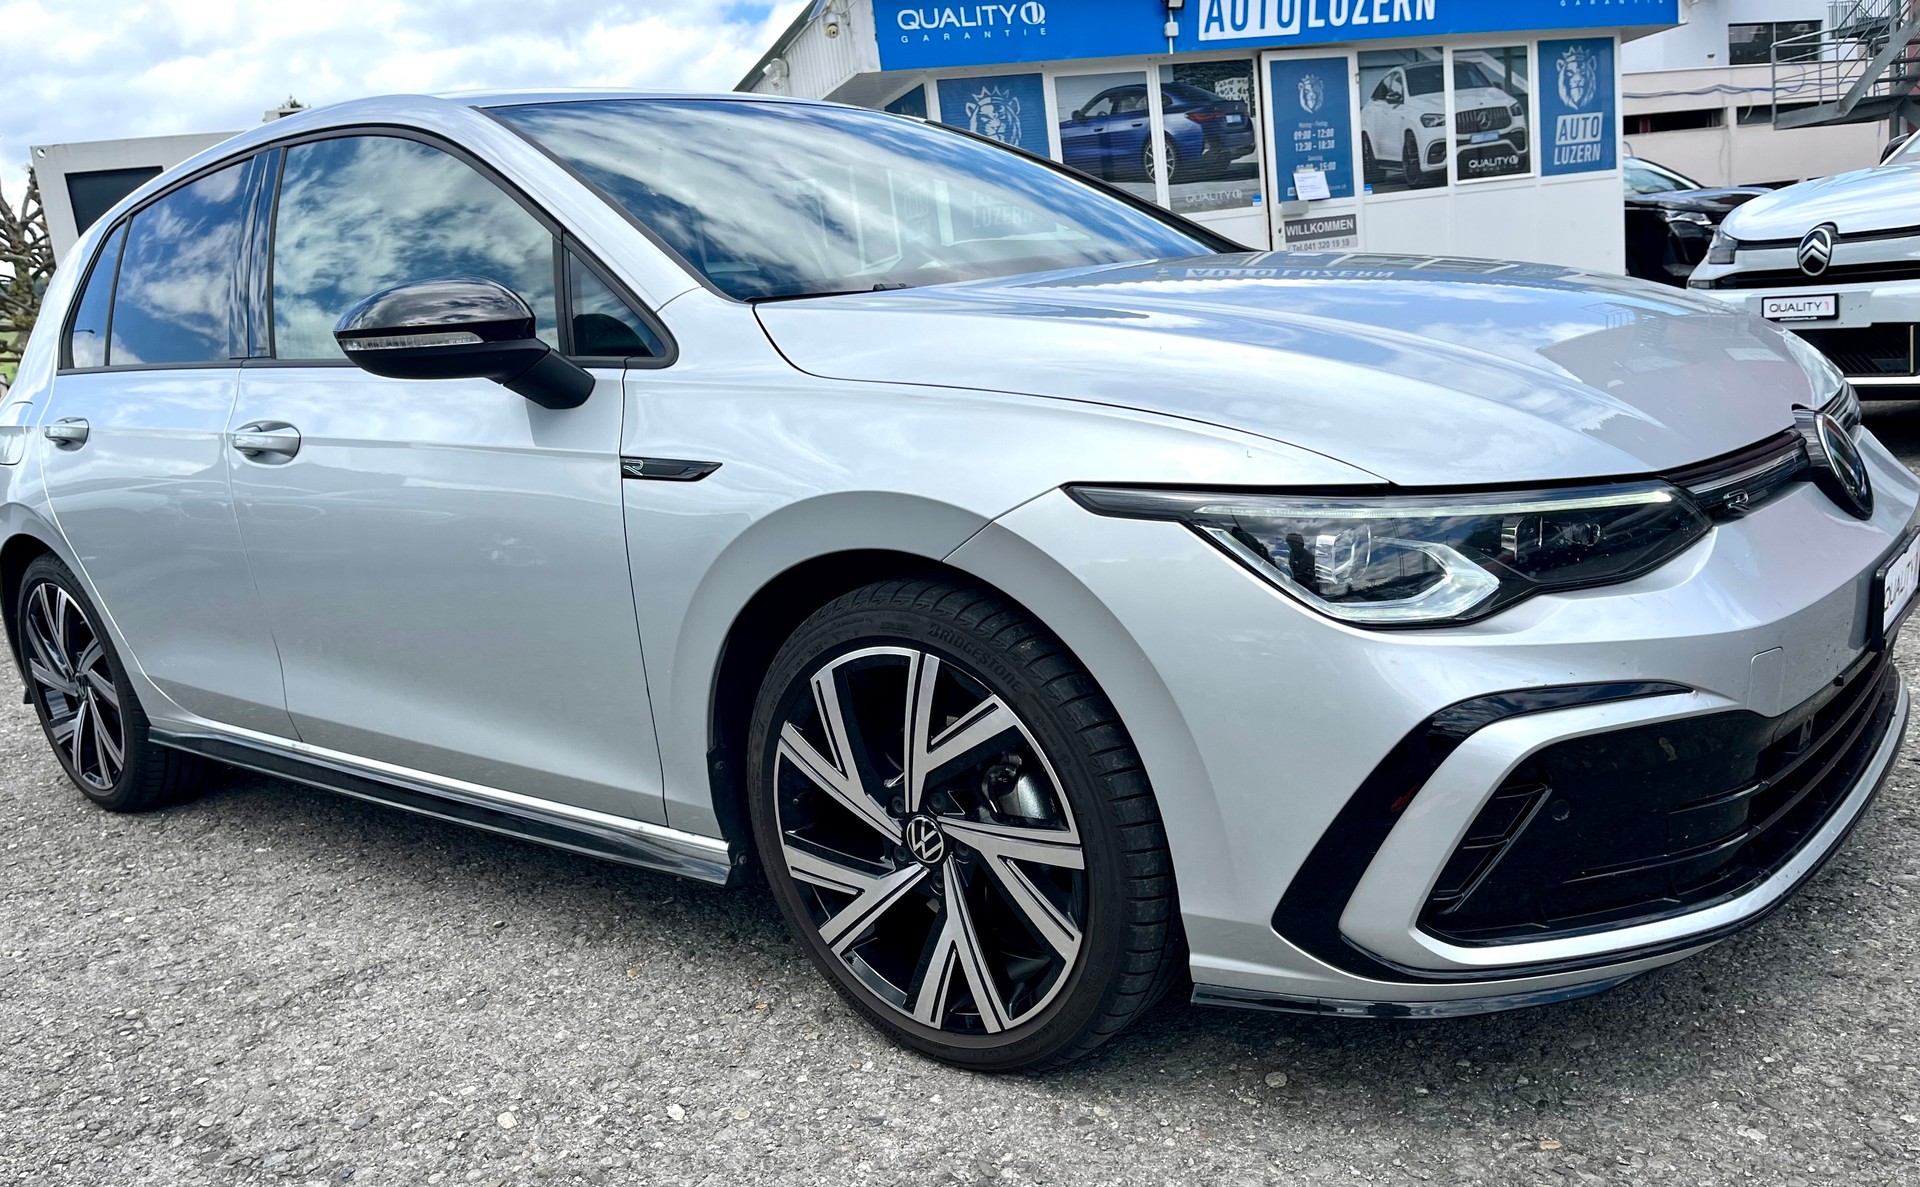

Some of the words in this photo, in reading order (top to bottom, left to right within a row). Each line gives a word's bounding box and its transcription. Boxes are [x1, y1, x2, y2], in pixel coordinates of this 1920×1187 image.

[897, 4, 1017, 30] QUALITY
[1203, 0, 1295, 33] AUTO
[900, 27, 1047, 44] GARANTIE
[1558, 115, 1600, 141] AUTO
[1468, 156, 1509, 168] QUALITY
[1553, 142, 1601, 165] LUZERN
[1185, 191, 1232, 203] QUALITY
[1286, 218, 1354, 236] WILLKOMMEN
[1318, 240, 1330, 249] 320
[1332, 239, 1340, 247] 19
[1342, 238, 1350, 246] 19
[1769, 301, 1822, 313] QUALITY
[926, 622, 1025, 693] BRIDGESTONE
